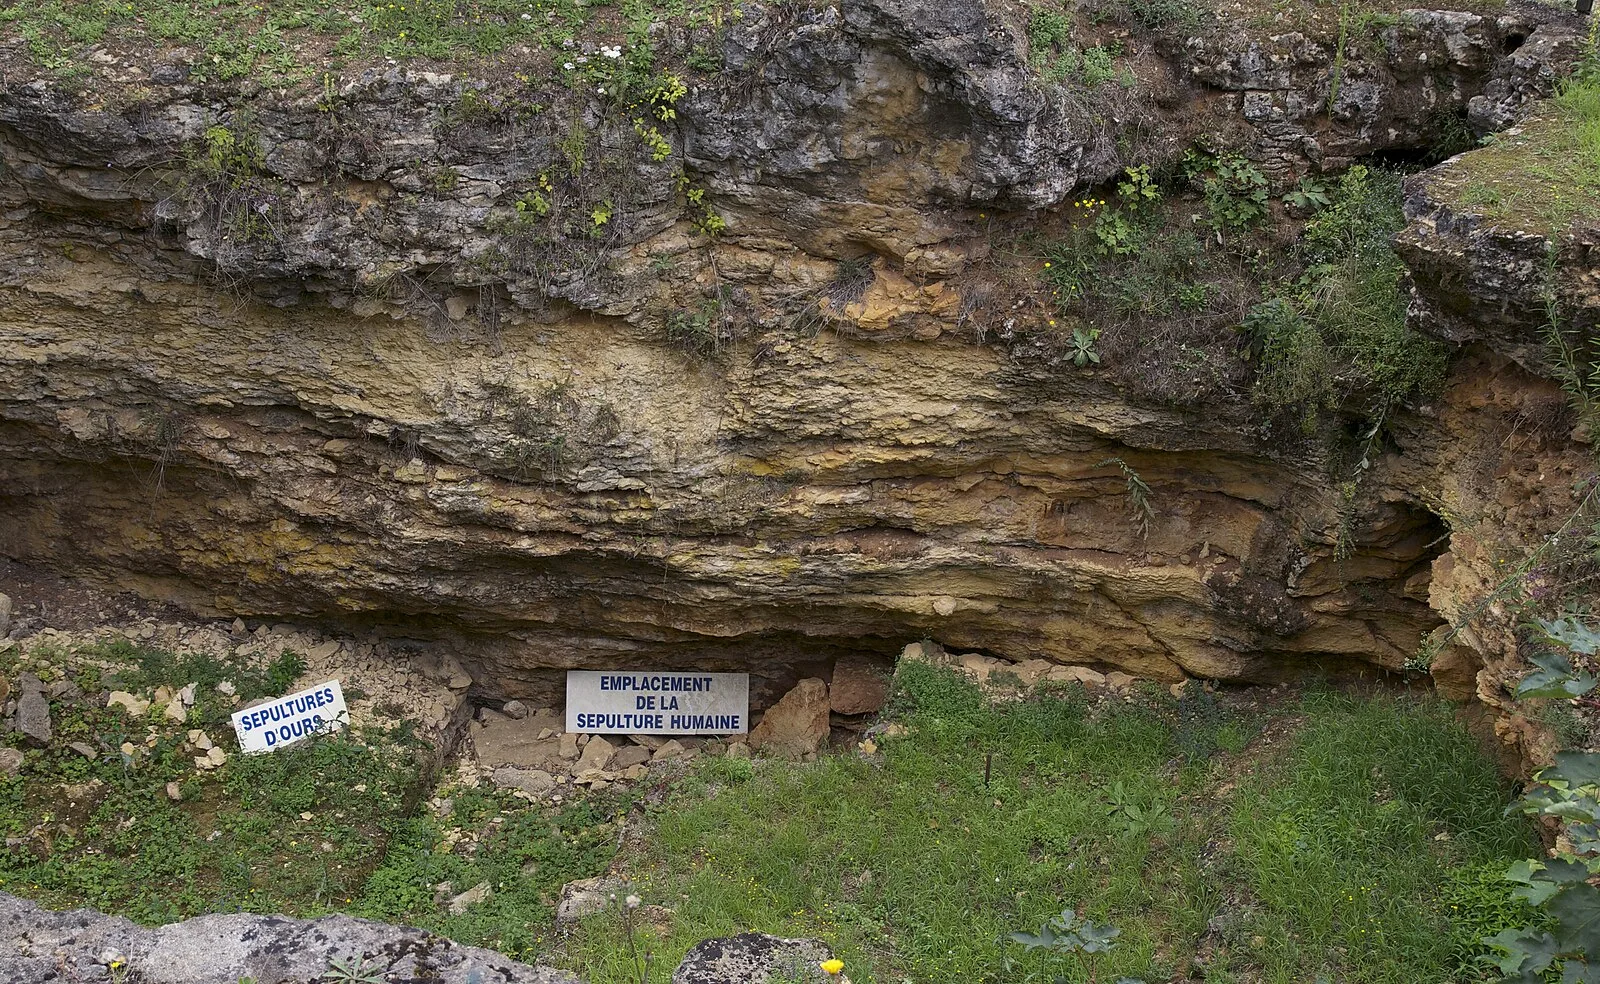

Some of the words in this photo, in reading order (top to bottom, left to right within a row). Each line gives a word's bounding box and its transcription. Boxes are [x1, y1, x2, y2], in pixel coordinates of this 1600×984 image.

[600, 676, 712, 691] EMPLACEMENT
[241, 688, 334, 731] SEPULTURES
[636, 695, 656, 710] DE
[660, 696, 679, 710] LA
[577, 713, 663, 729] SEPULTURE
[670, 715, 740, 729] HUMAINE
